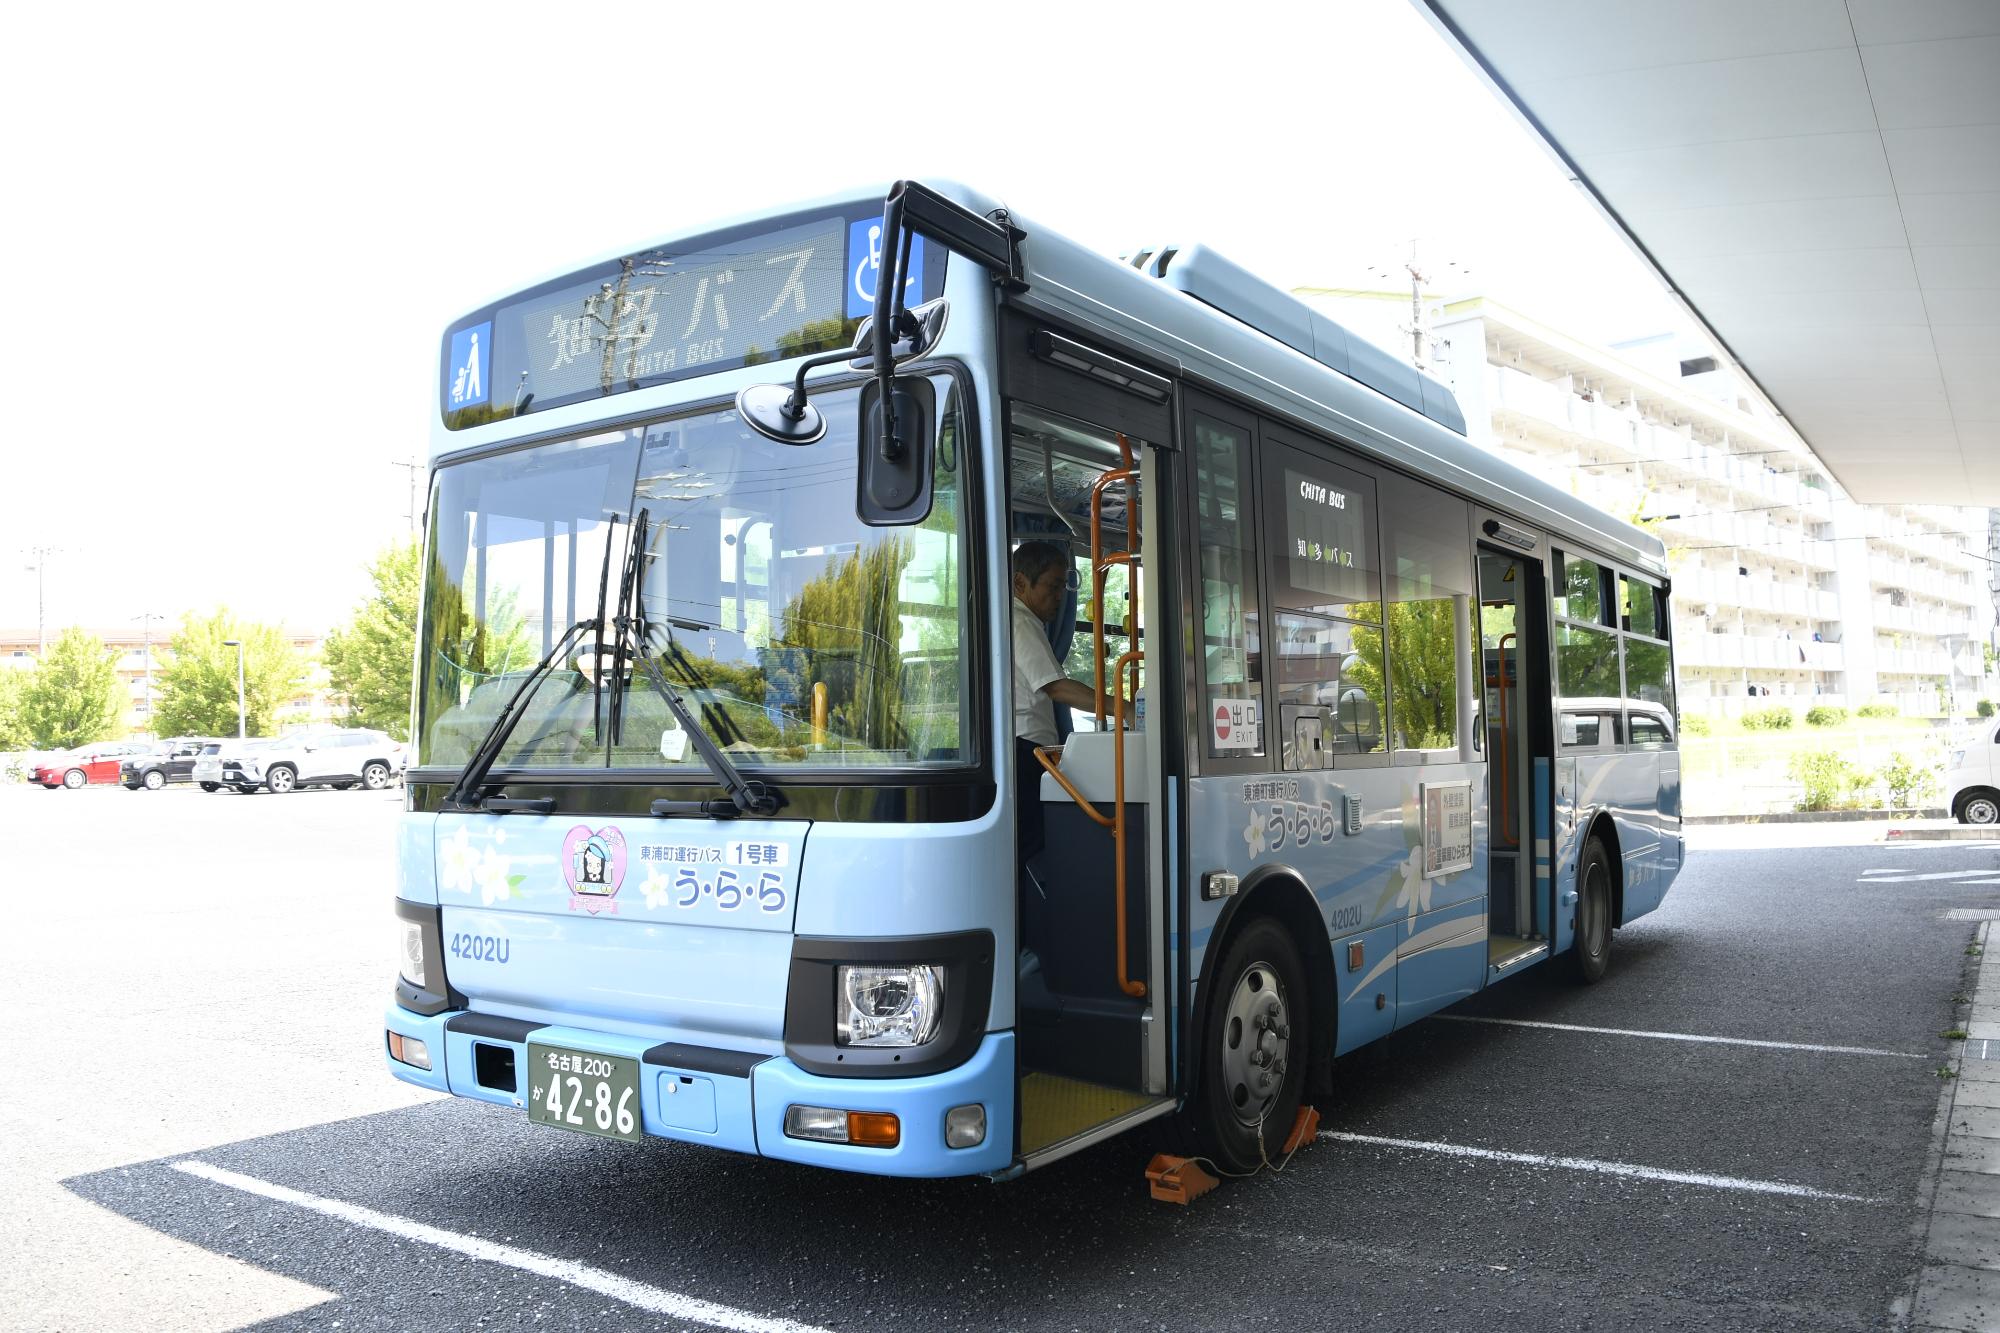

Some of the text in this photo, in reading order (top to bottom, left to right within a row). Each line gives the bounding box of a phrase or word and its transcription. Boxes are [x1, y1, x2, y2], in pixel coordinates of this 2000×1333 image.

[548, 247, 815, 372] 知多バス
[623, 338, 723, 378] CHITA BUS
[1300, 481, 1345, 509] CHITA BUS
[1232, 704, 1255, 726] 出口
[1235, 731, 1253, 743] EXIT
[1243, 780, 1299, 801] 東浦町運行バス
[640, 843, 779, 865] 東浦町運行バス 1号車
[1331, 905, 1362, 931] 4202U
[450, 933, 510, 964] 4202U
[532, 1073, 635, 1135] か 42-86
